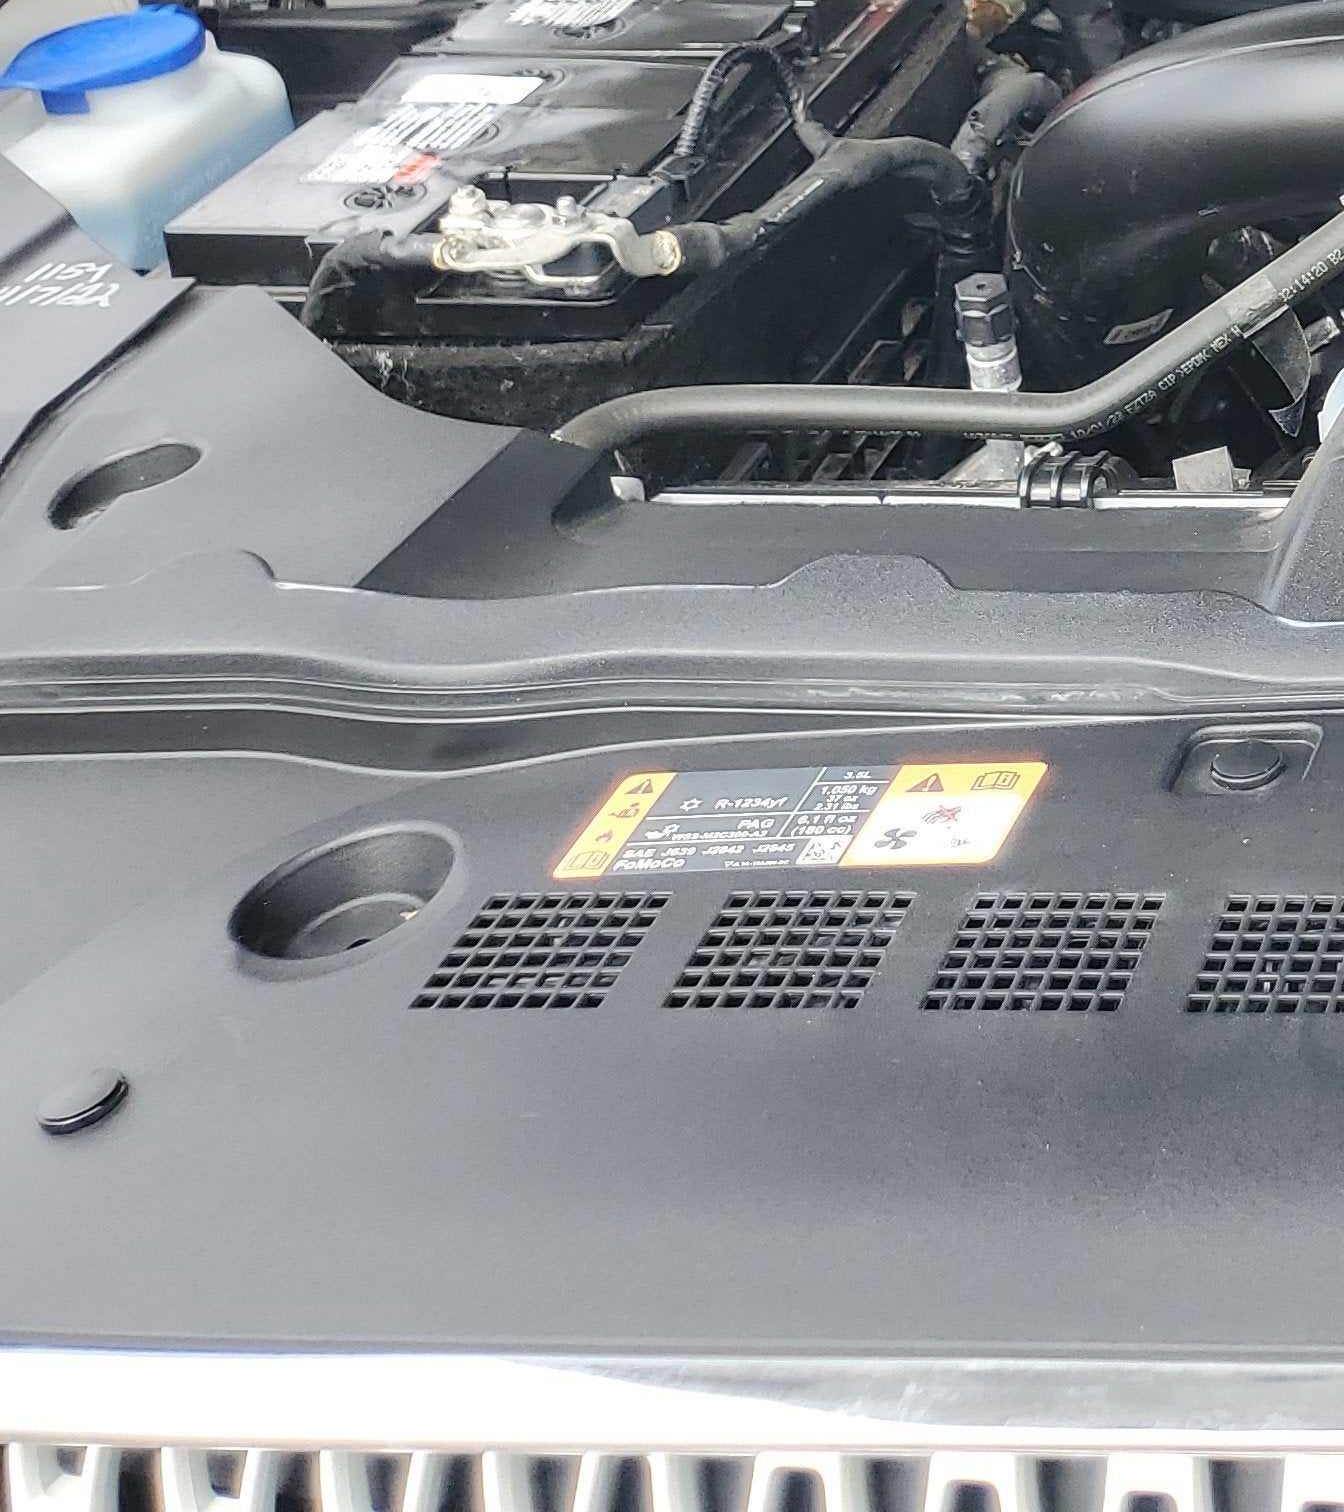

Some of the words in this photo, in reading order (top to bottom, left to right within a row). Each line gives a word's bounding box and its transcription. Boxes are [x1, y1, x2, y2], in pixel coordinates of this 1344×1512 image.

[859, 785, 878, 796] kg
[714, 796, 789, 810] R-1234yf
[736, 818, 776, 830] PAG
[622, 848, 657, 859] SAE
[612, 857, 687, 871] FoMoCo
